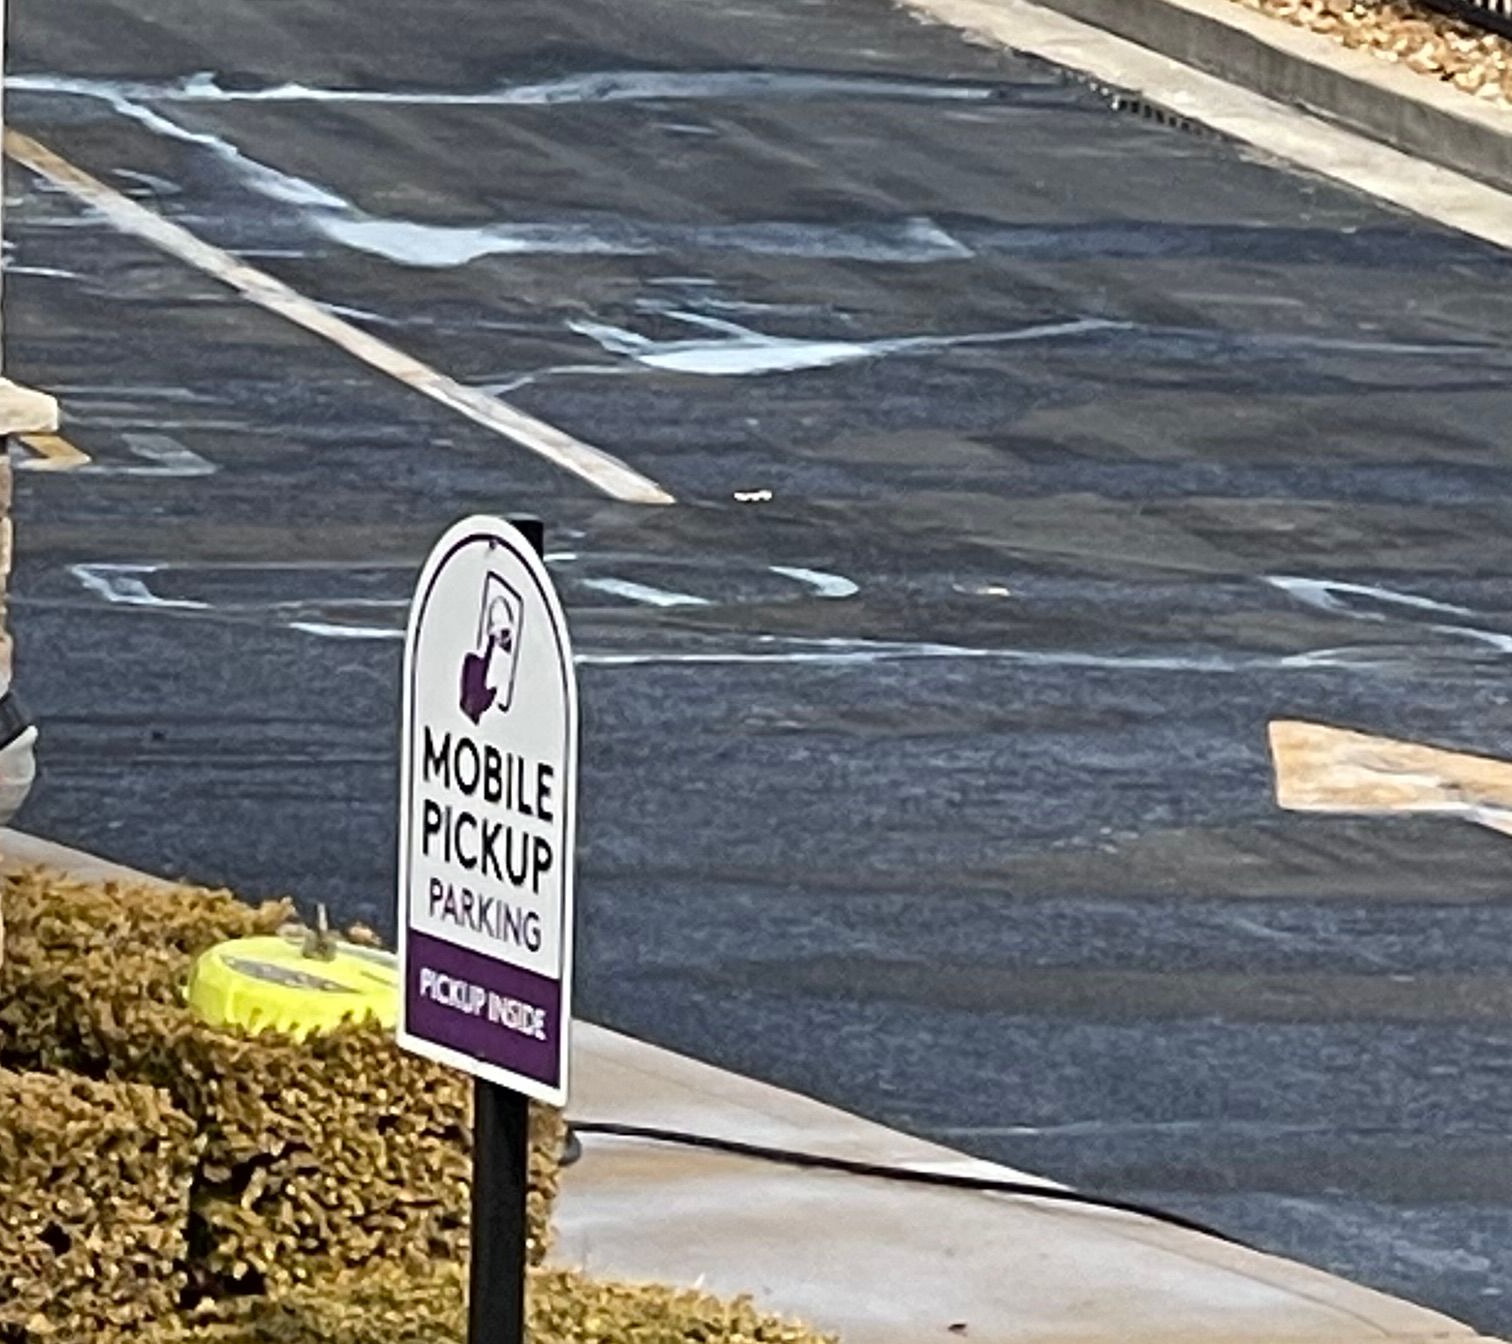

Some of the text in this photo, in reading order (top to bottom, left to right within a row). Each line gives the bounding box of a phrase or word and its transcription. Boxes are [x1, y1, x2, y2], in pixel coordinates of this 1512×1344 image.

[422, 725, 554, 823] MOBILE
[422, 798, 554, 894] PICKUP
[429, 876, 541, 953] PARKING
[419, 966, 486, 1016] PICKUP
[487, 990, 548, 1042] INSIDE
